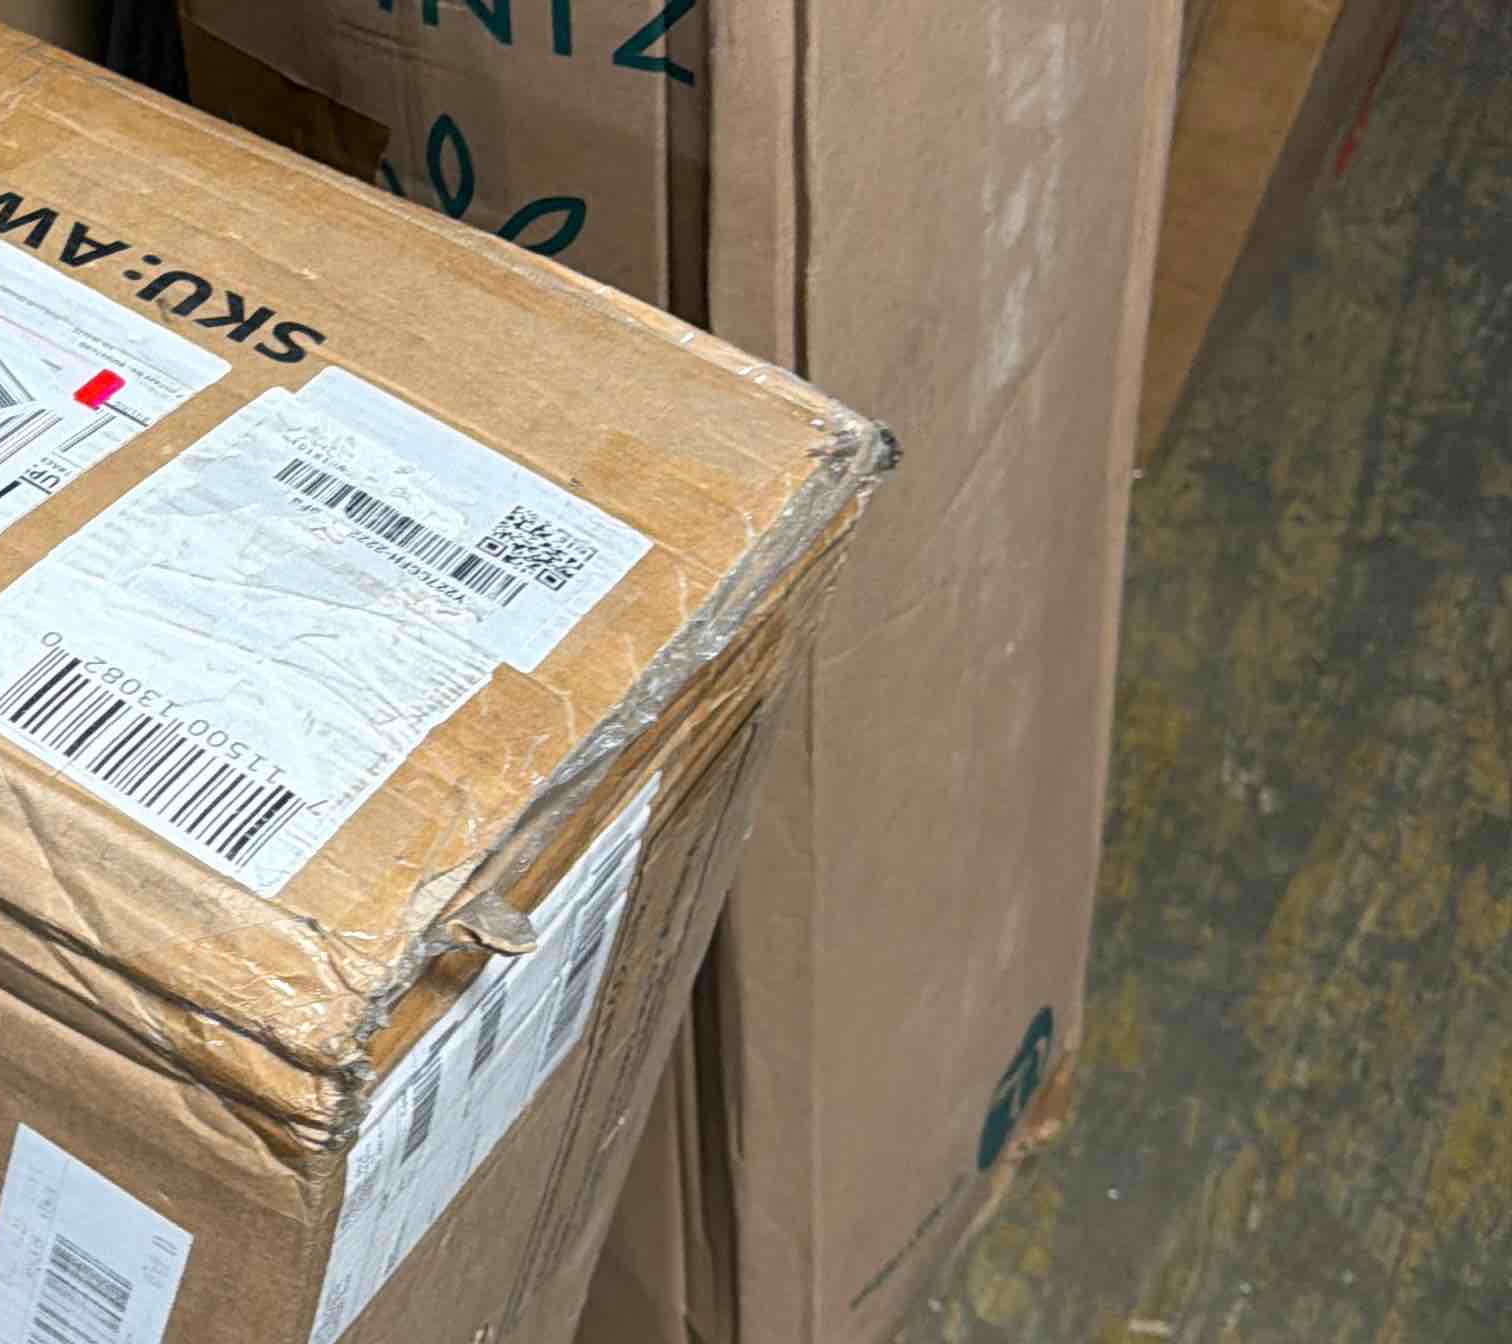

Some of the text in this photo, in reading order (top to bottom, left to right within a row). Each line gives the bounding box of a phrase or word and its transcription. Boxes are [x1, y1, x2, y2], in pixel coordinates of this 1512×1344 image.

[36, 628, 66, 650] 0
[77, 653, 183, 719] 13082
[180, 716, 290, 784] 11500
